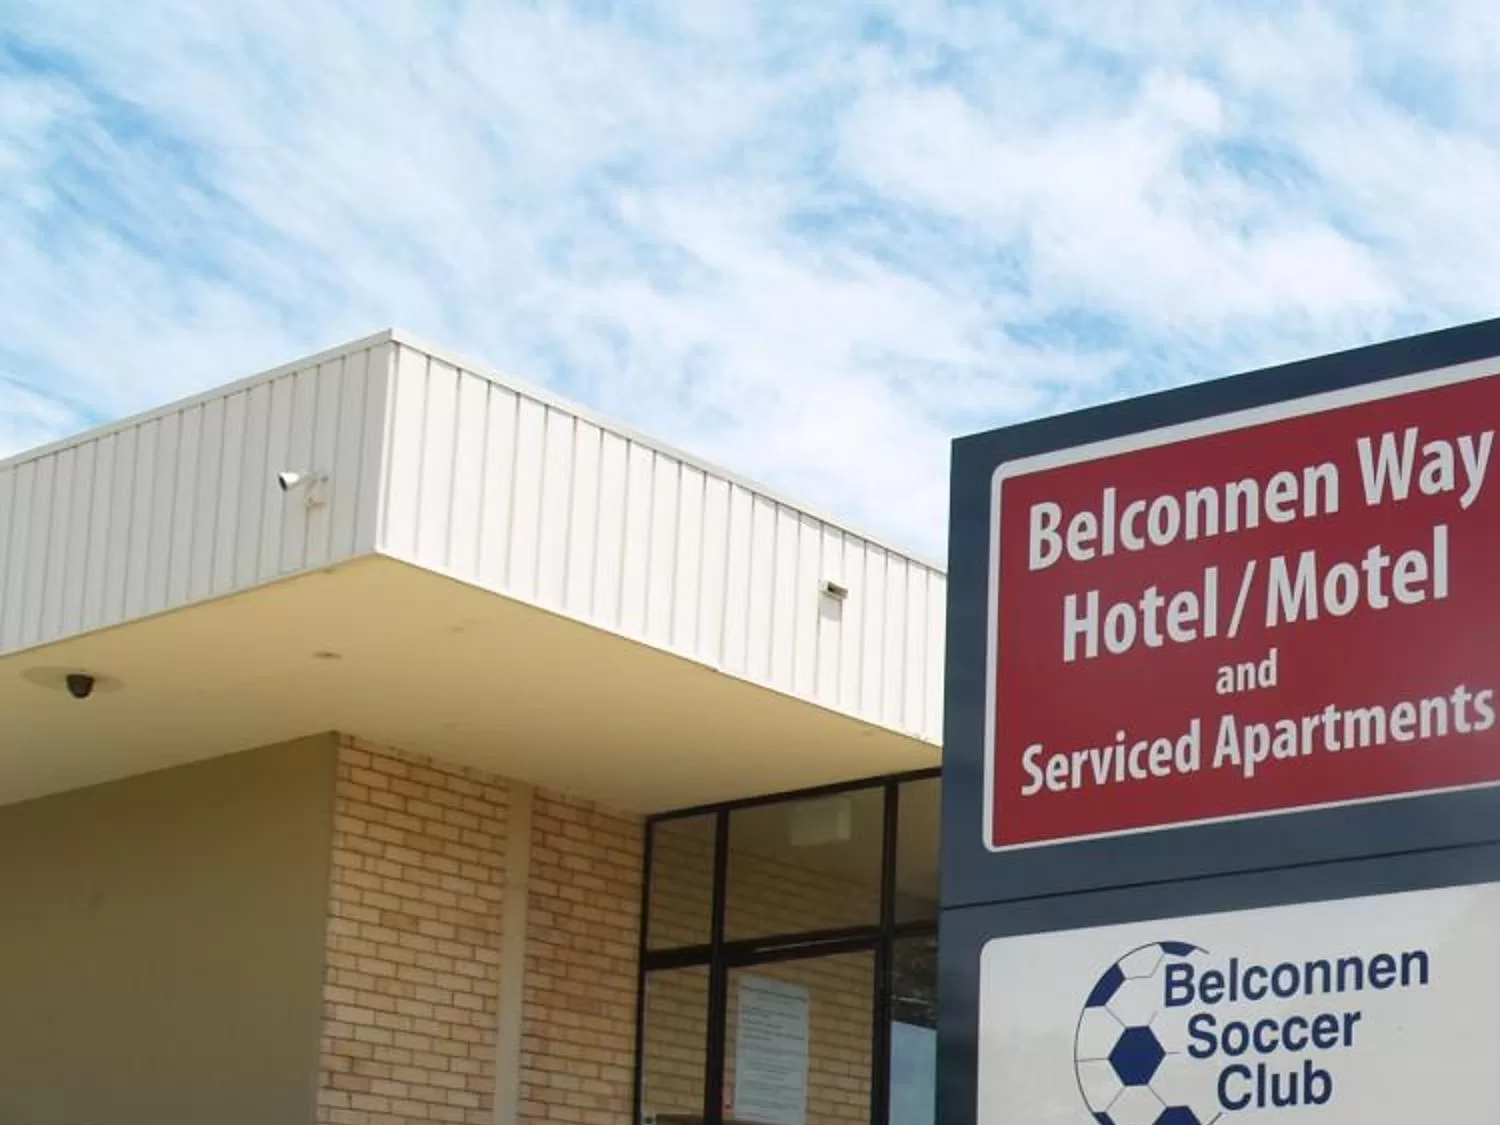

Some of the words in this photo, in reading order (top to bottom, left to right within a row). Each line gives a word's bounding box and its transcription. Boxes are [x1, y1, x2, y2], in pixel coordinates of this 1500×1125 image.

[1028, 462, 1339, 571] Belconnen
[1357, 427, 1495, 510] Way
[1216, 649, 1277, 695] and
[1021, 720, 1200, 797] Serviced
[1213, 684, 1495, 779] Apartments
[1164, 949, 1429, 1007] Belconnen
[1187, 1011, 1361, 1059] Soccer
[1217, 1060, 1332, 1111] Club
